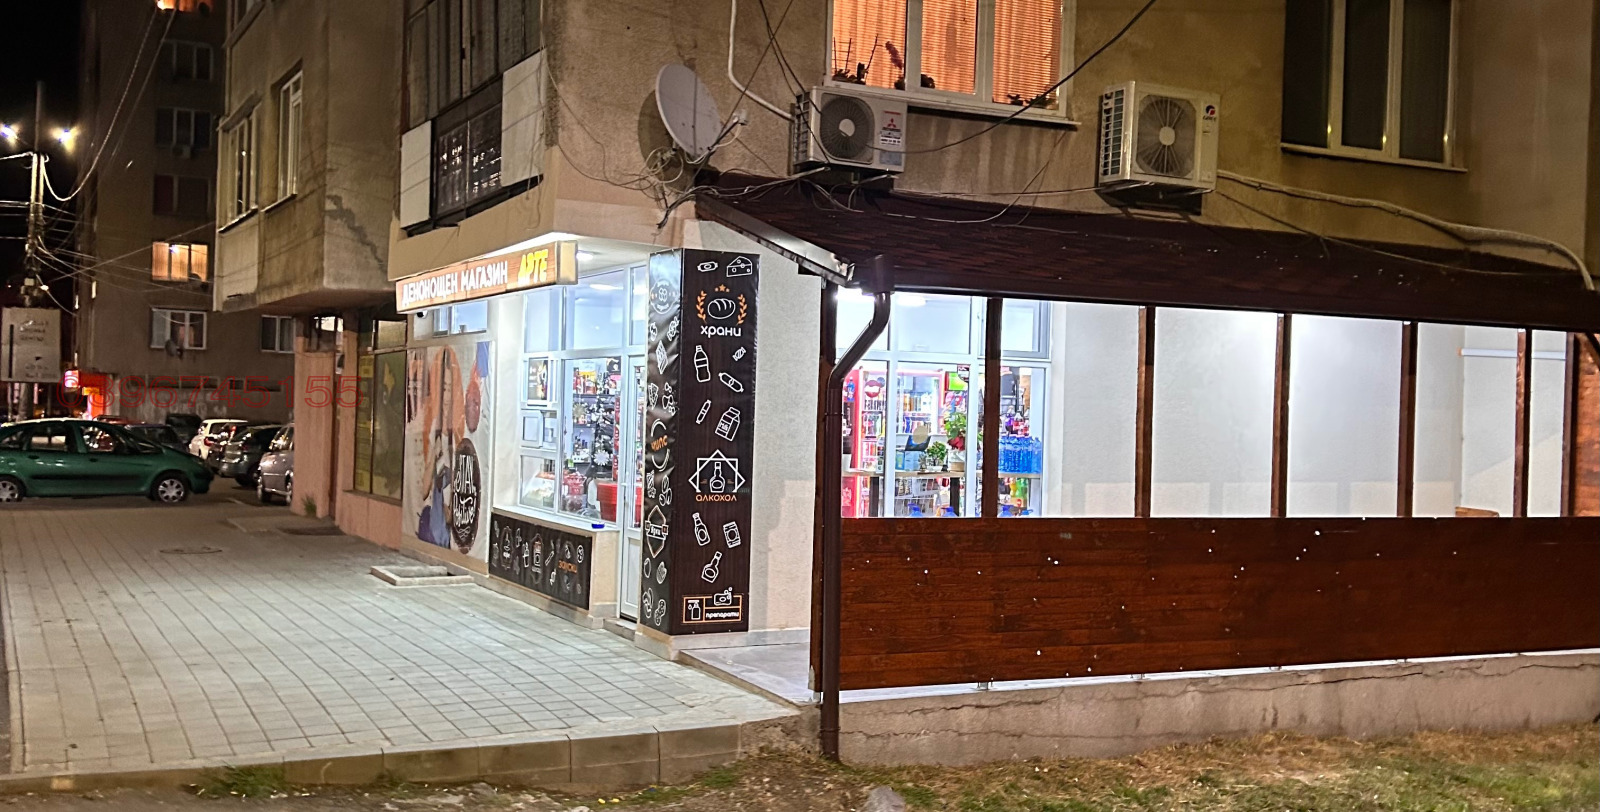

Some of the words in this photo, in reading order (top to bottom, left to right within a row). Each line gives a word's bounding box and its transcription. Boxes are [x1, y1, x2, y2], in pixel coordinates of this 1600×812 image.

[402, 273, 459, 307] ДЕНОНОЩЕН
[460, 260, 509, 295] МАГАЗИН
[517, 248, 549, 286] АРТЕ
[700, 325, 742, 338] храни
